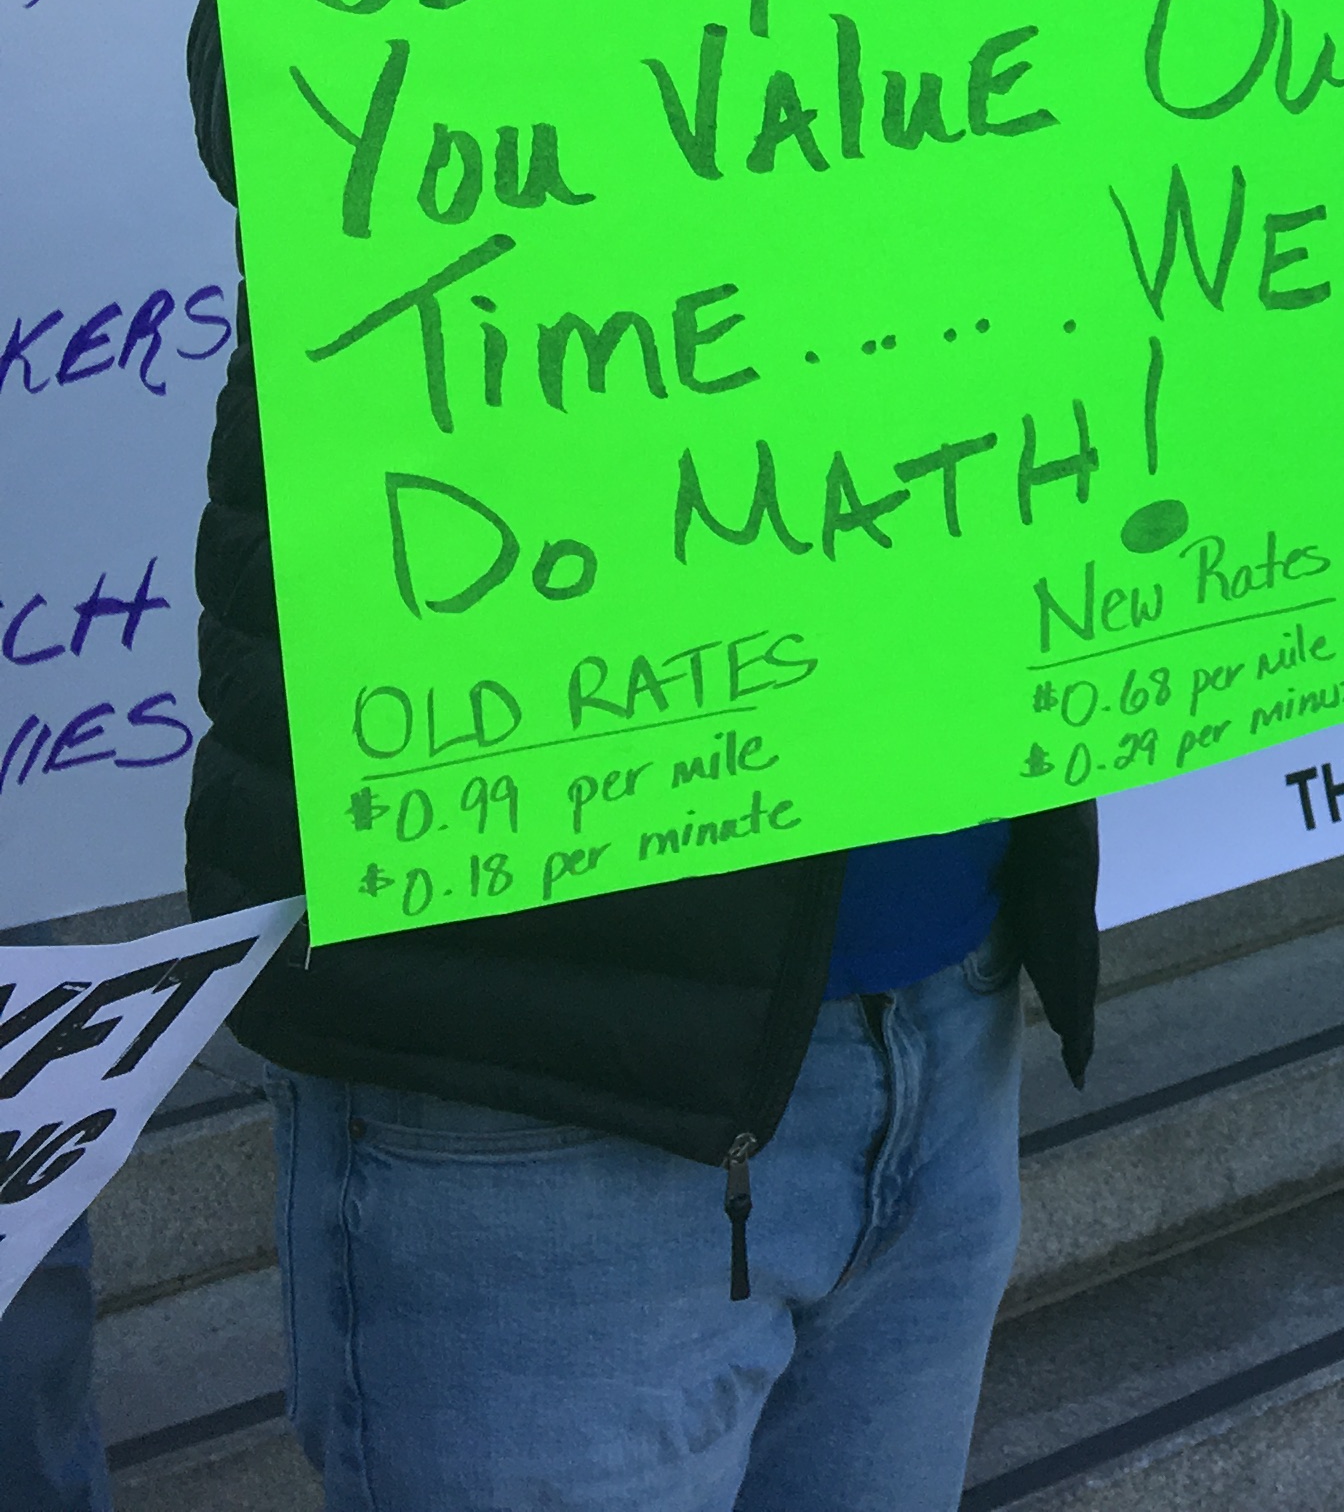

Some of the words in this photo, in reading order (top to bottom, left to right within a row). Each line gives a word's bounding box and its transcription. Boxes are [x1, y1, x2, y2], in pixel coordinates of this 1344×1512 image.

[1034, 561, 1165, 653] New
[1178, 530, 1331, 606] Rates
[352, 679, 522, 760] OLD
[568, 630, 819, 730] RATES
[1033, 668, 1172, 727] $0.68
[1190, 662, 1246, 719] per
[1256, 624, 1336, 677] mile
[346, 775, 519, 842] $0.99
[567, 764, 651, 834] per
[671, 728, 780, 788] mile
[1176, 709, 1243, 770] per
[359, 852, 513, 918] $0.18
[541, 842, 612, 901] per
